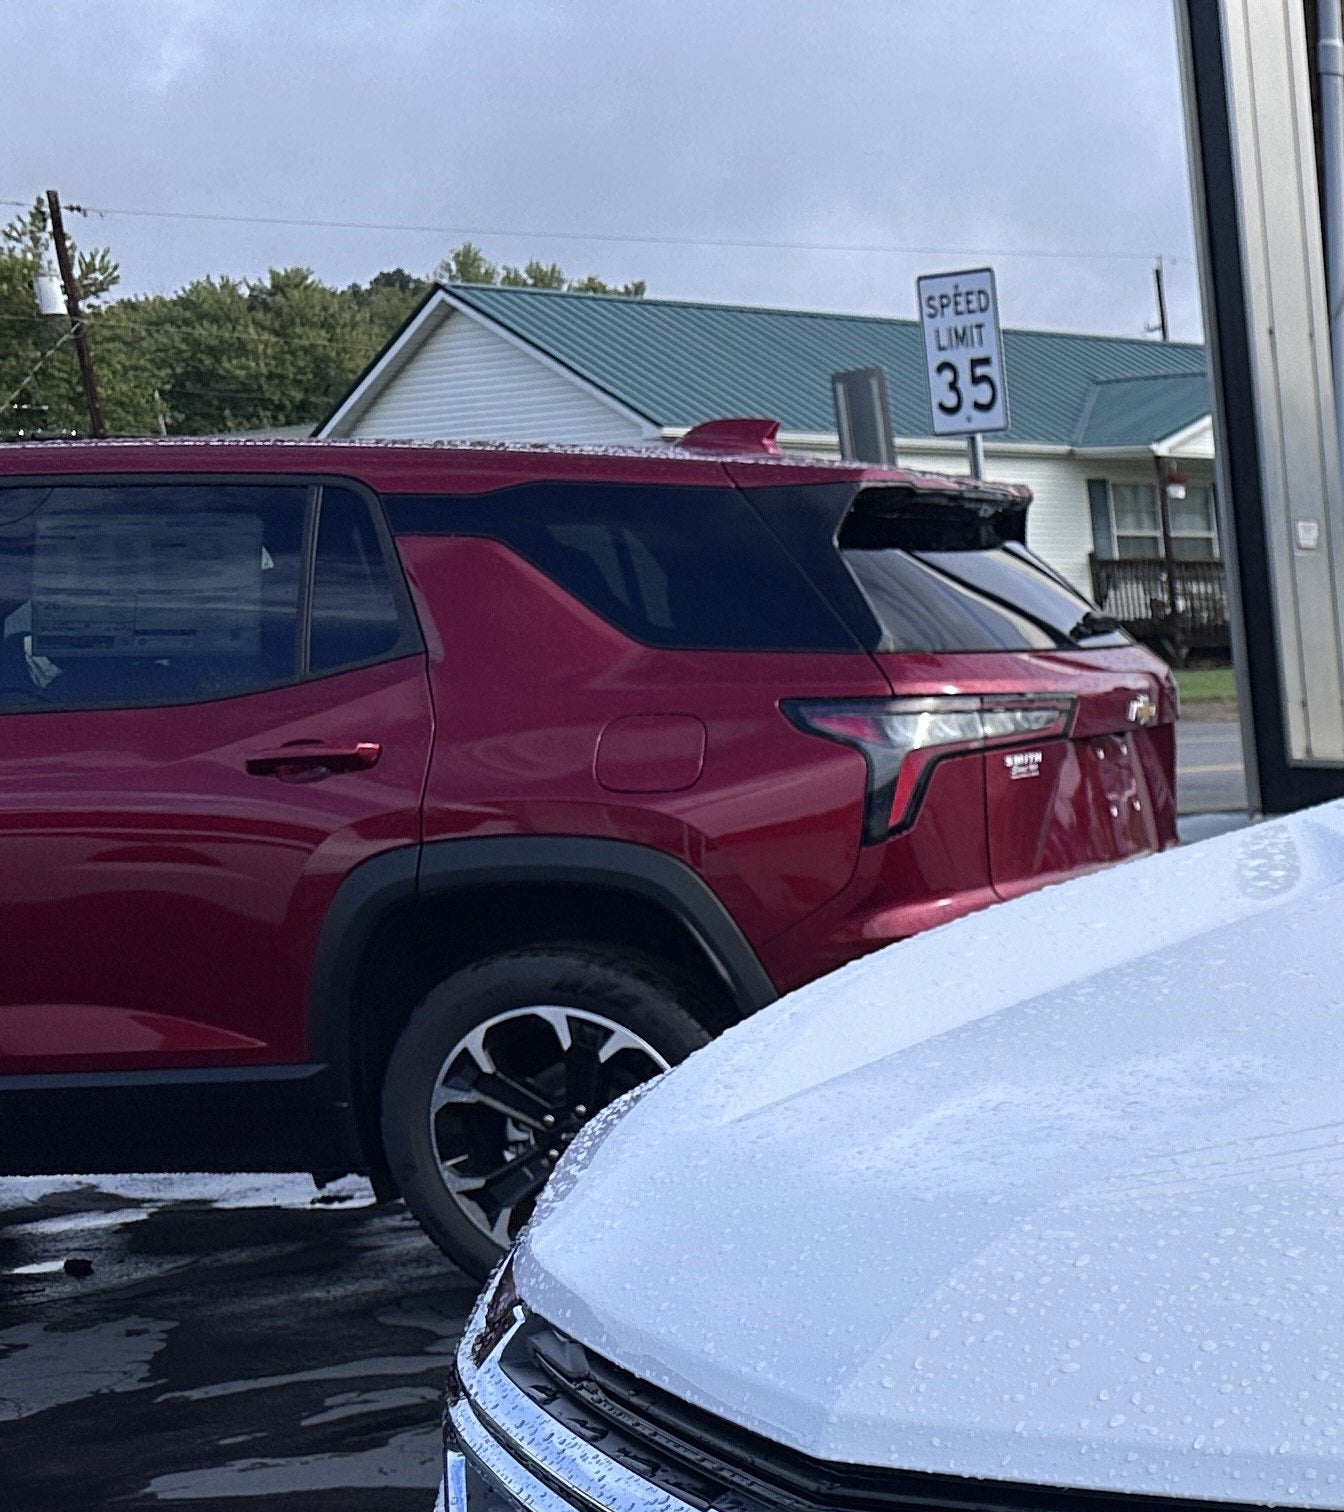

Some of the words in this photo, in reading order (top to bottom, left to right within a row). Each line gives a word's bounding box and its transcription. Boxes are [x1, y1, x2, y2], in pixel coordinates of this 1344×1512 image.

[925, 288, 990, 319] SPEED
[934, 323, 986, 351] LIMIT
[935, 356, 998, 416] 35
